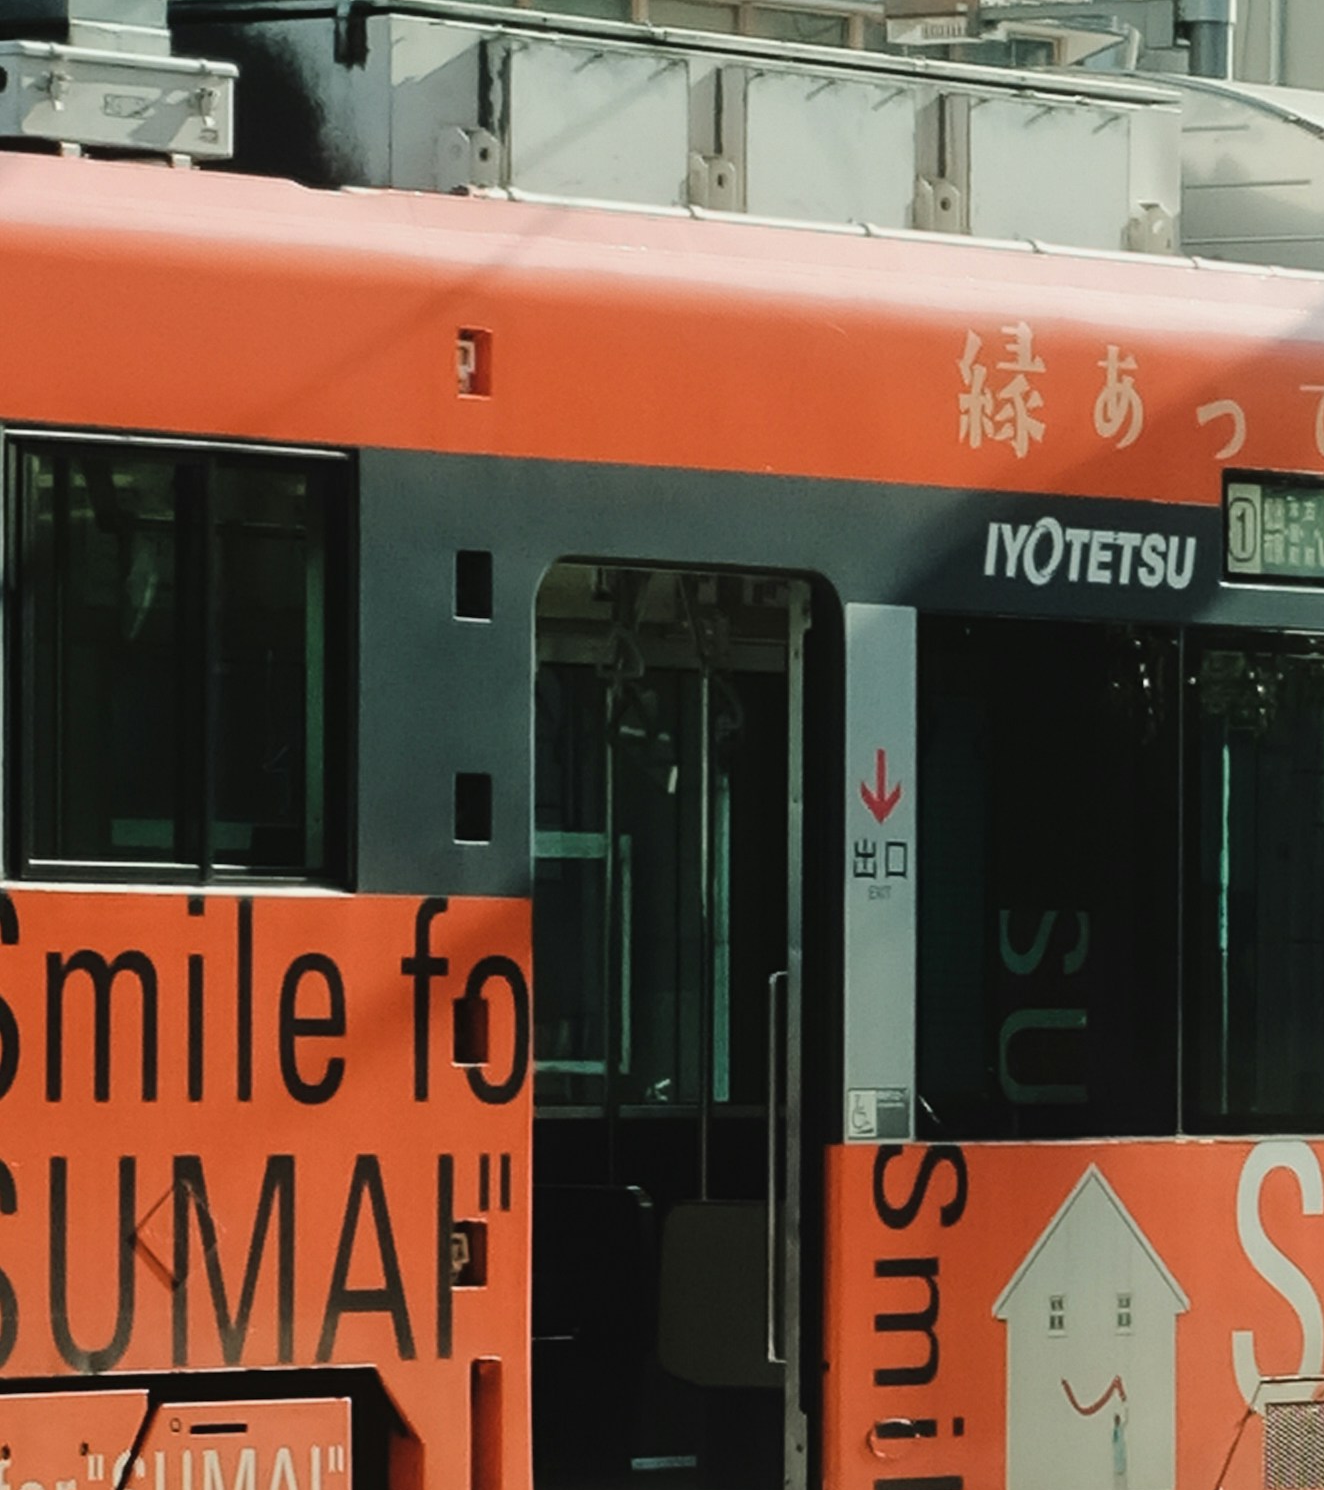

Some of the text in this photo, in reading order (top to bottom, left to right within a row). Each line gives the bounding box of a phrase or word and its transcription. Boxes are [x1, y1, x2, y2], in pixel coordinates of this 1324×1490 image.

[985, 516, 1196, 588] IYOTETSU
[853, 838, 908, 880] 出口
[0, 893, 346, 1105] mile
[0, 1153, 511, 1373] UMAI"
